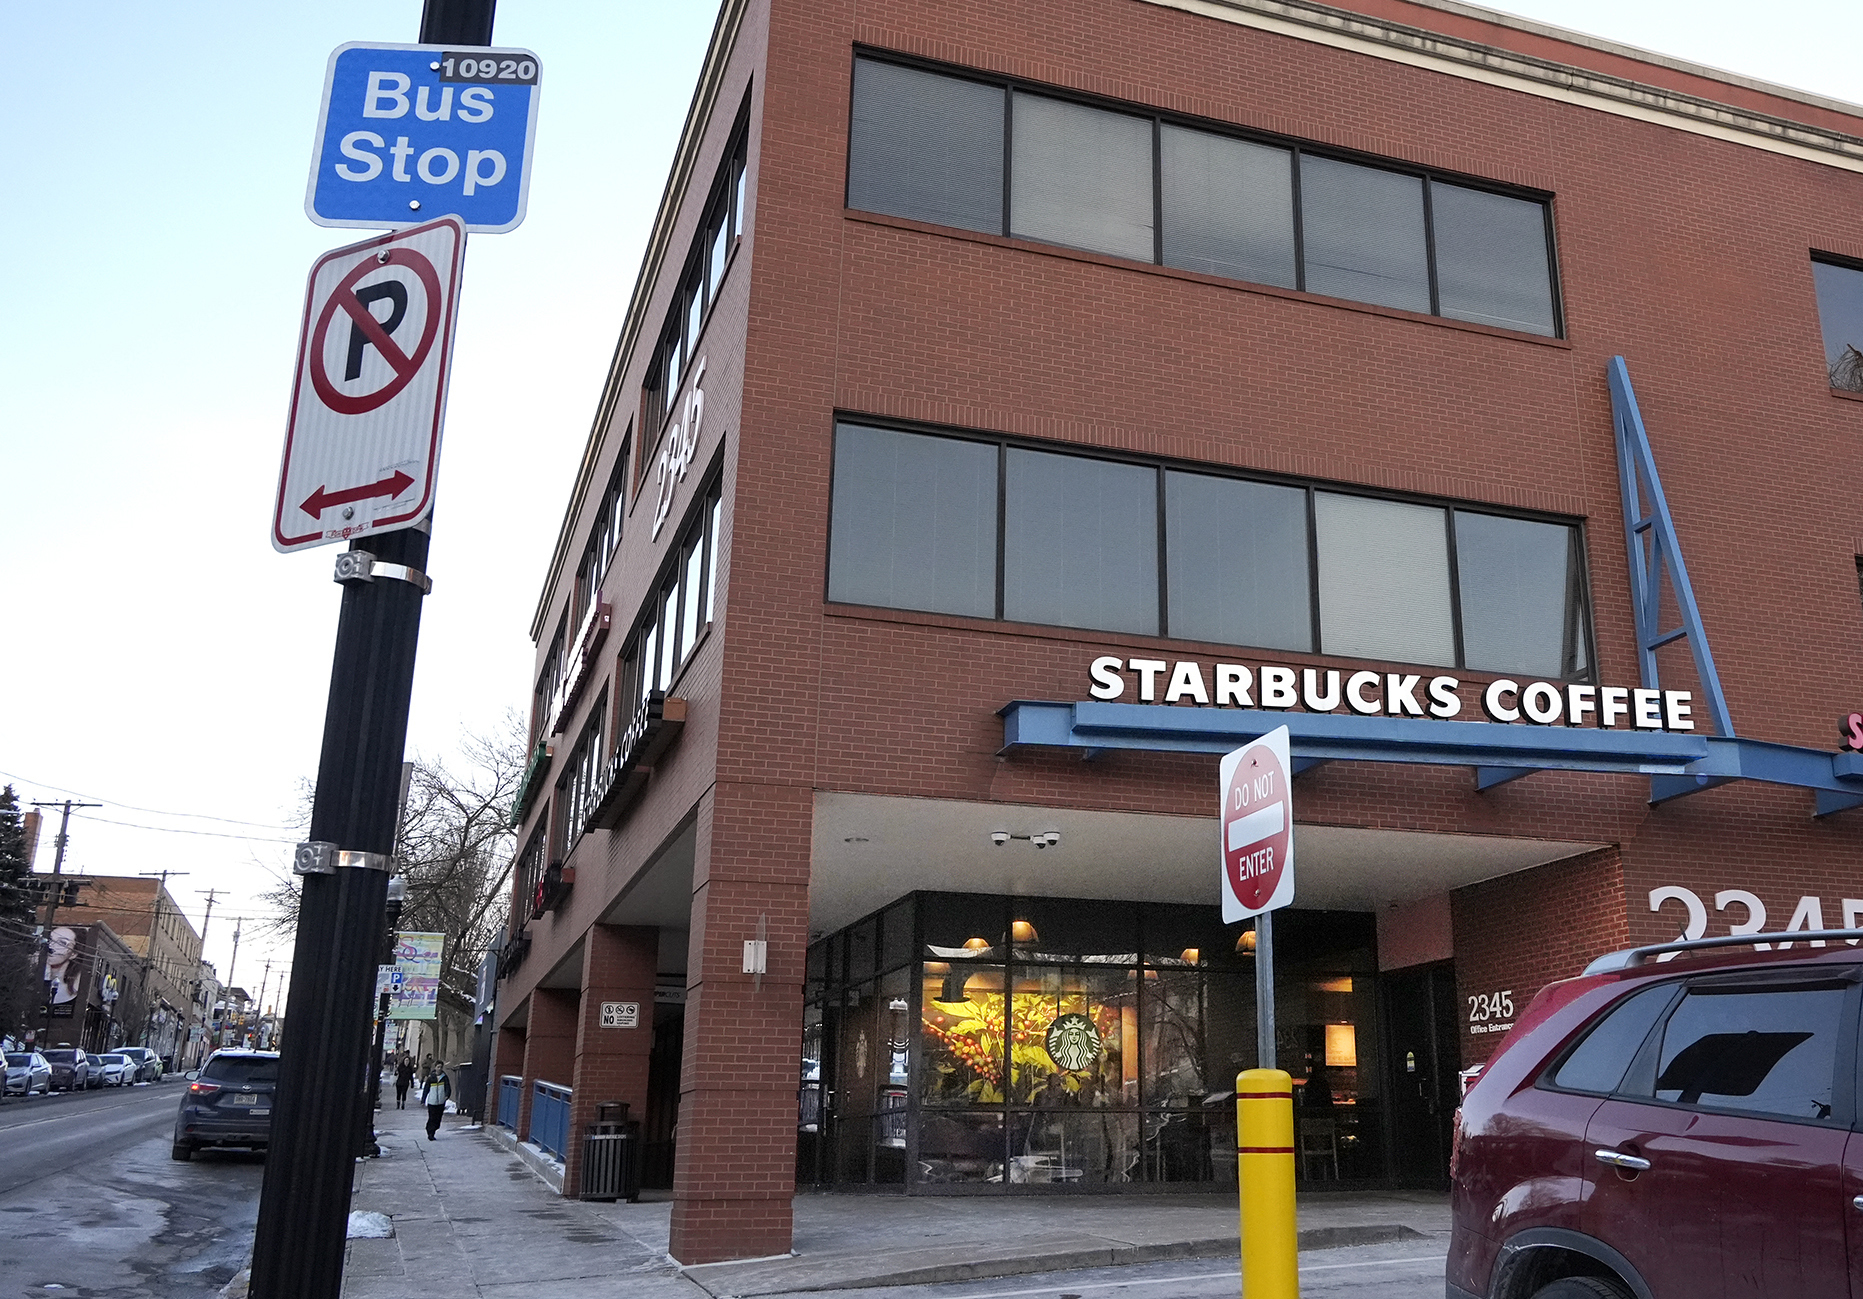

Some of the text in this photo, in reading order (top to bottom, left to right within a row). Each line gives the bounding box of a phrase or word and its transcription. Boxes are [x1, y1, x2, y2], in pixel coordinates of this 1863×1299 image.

[442, 58, 536, 80] 10920
[362, 71, 495, 123] Bus
[335, 130, 507, 196] Stop
[652, 355, 707, 543] 2345
[1089, 656, 1695, 731] STARBUCKS COFFEE
[1234, 770, 1274, 811] DO NOT
[1239, 846, 1274, 881] ENTER
[603, 1015, 615, 1025] NO
[1468, 990, 1514, 1022] 2345
[1470, 1024, 1488, 1035] Office
